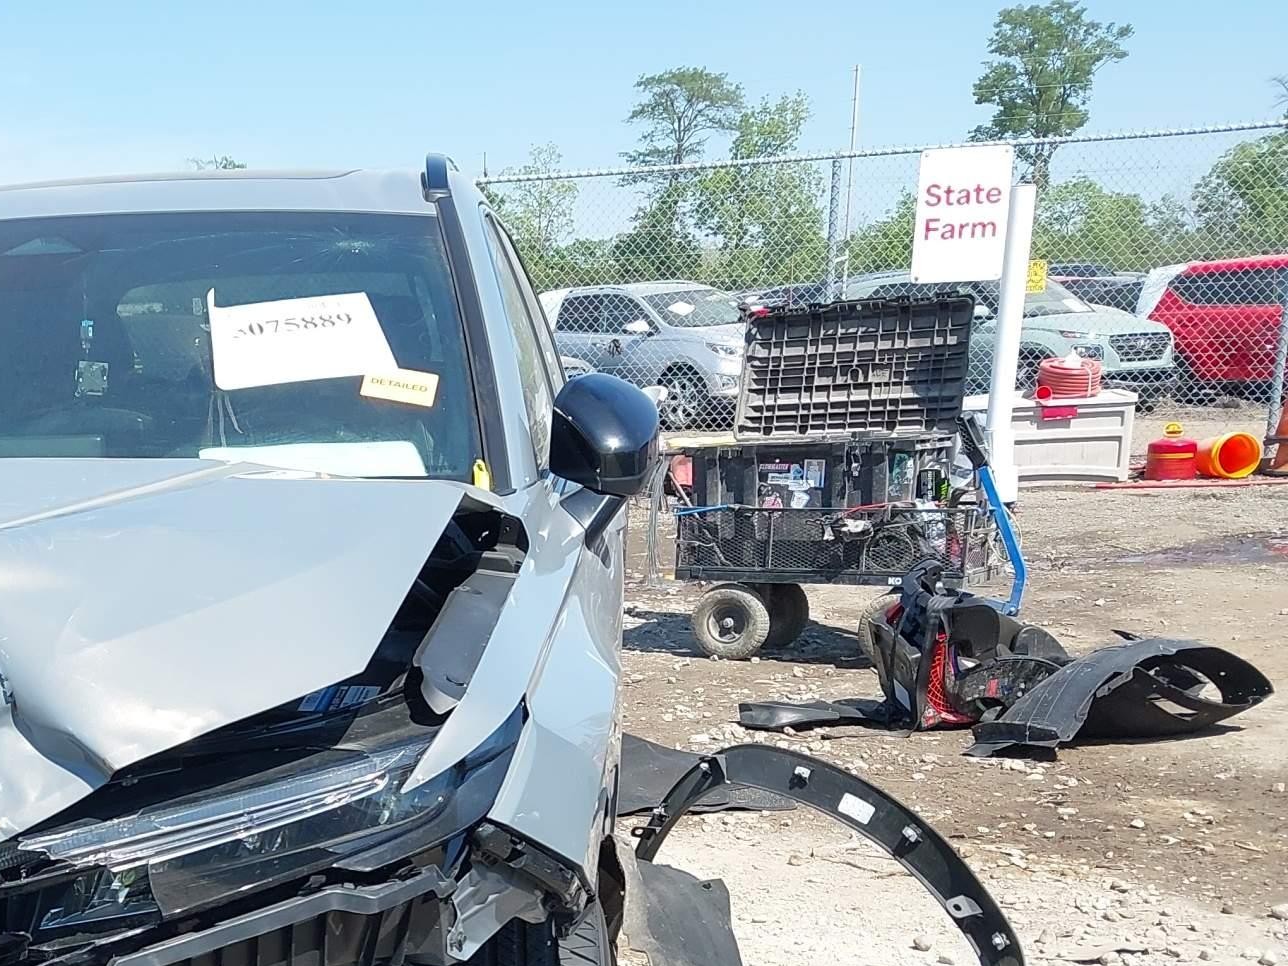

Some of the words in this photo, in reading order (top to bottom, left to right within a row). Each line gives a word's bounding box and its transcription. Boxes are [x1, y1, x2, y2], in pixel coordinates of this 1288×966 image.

[924, 183, 1002, 207] State
[924, 217, 997, 241] Farm
[371, 377, 428, 392] DETAILED
